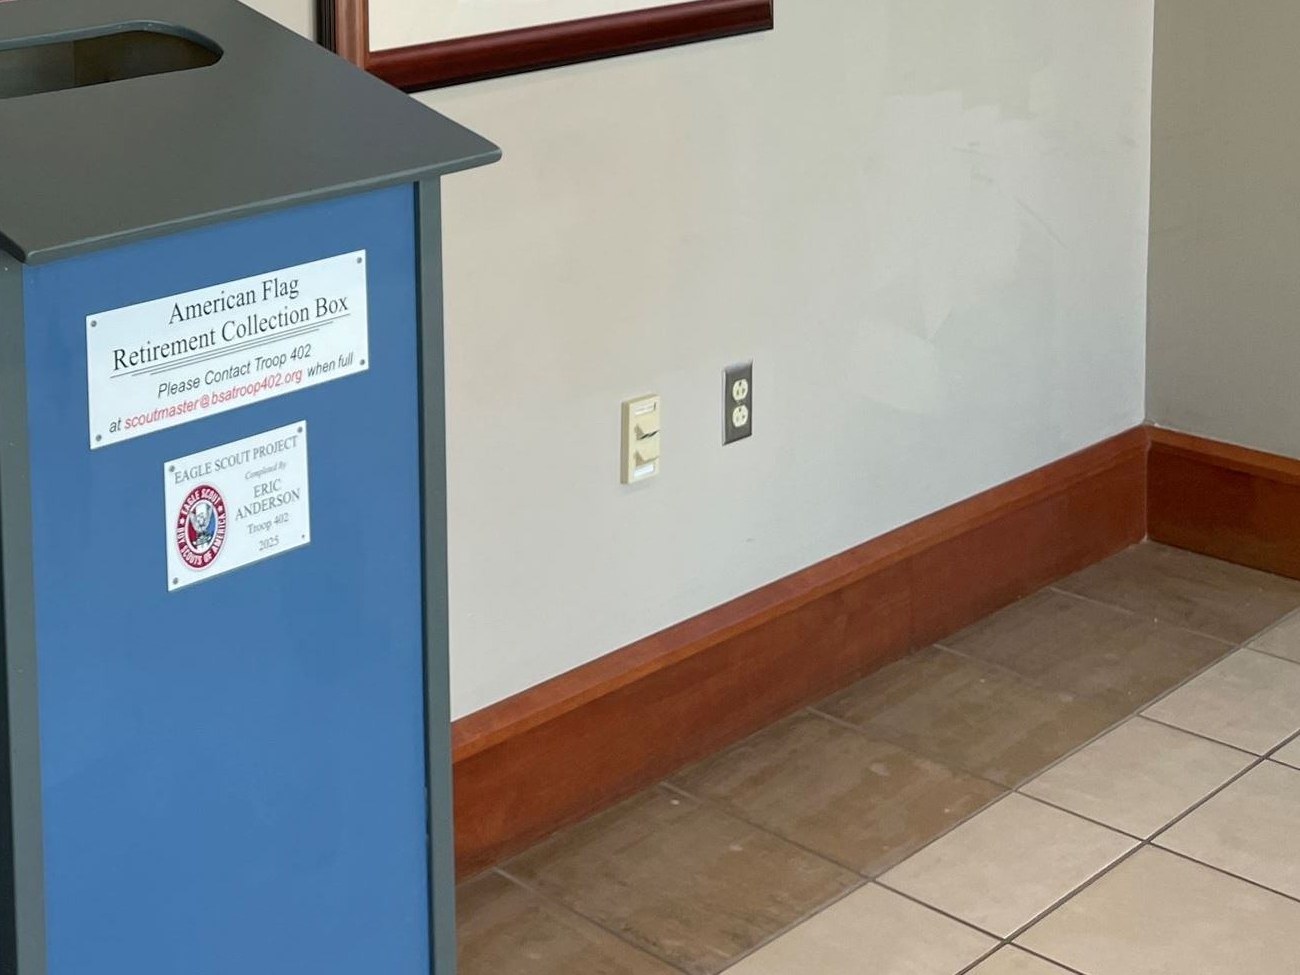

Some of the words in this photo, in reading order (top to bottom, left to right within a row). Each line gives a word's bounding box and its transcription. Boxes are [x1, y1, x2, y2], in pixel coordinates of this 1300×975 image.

[168, 289, 256, 324] American
[262, 278, 299, 301] Flag
[113, 329, 216, 370] Retirement
[221, 306, 309, 341] Collection
[315, 297, 348, 317] Box
[158, 377, 201, 398] Please
[204, 362, 251, 385] Contact
[254, 353, 287, 372] Troop
[290, 343, 311, 361] 402
[109, 418, 122, 433] at
[124, 370, 303, 429] scoutmaster@bsatroop402.org
[307, 359, 336, 378] when
[338, 351, 354, 369] full
[174, 462, 212, 484] EAGLE
[214, 450, 251, 472] SCOUT
[253, 435, 298, 460] PROJECT
[181, 489, 201, 515] EAGLE
[200, 488, 221, 505] SCOUT
[235, 487, 301, 521] ANDERSON
[253, 478, 281, 498] ERIC
[248, 521, 272, 534] Troop
[274, 512, 289, 524] 402
[259, 535, 279, 551] 2025
